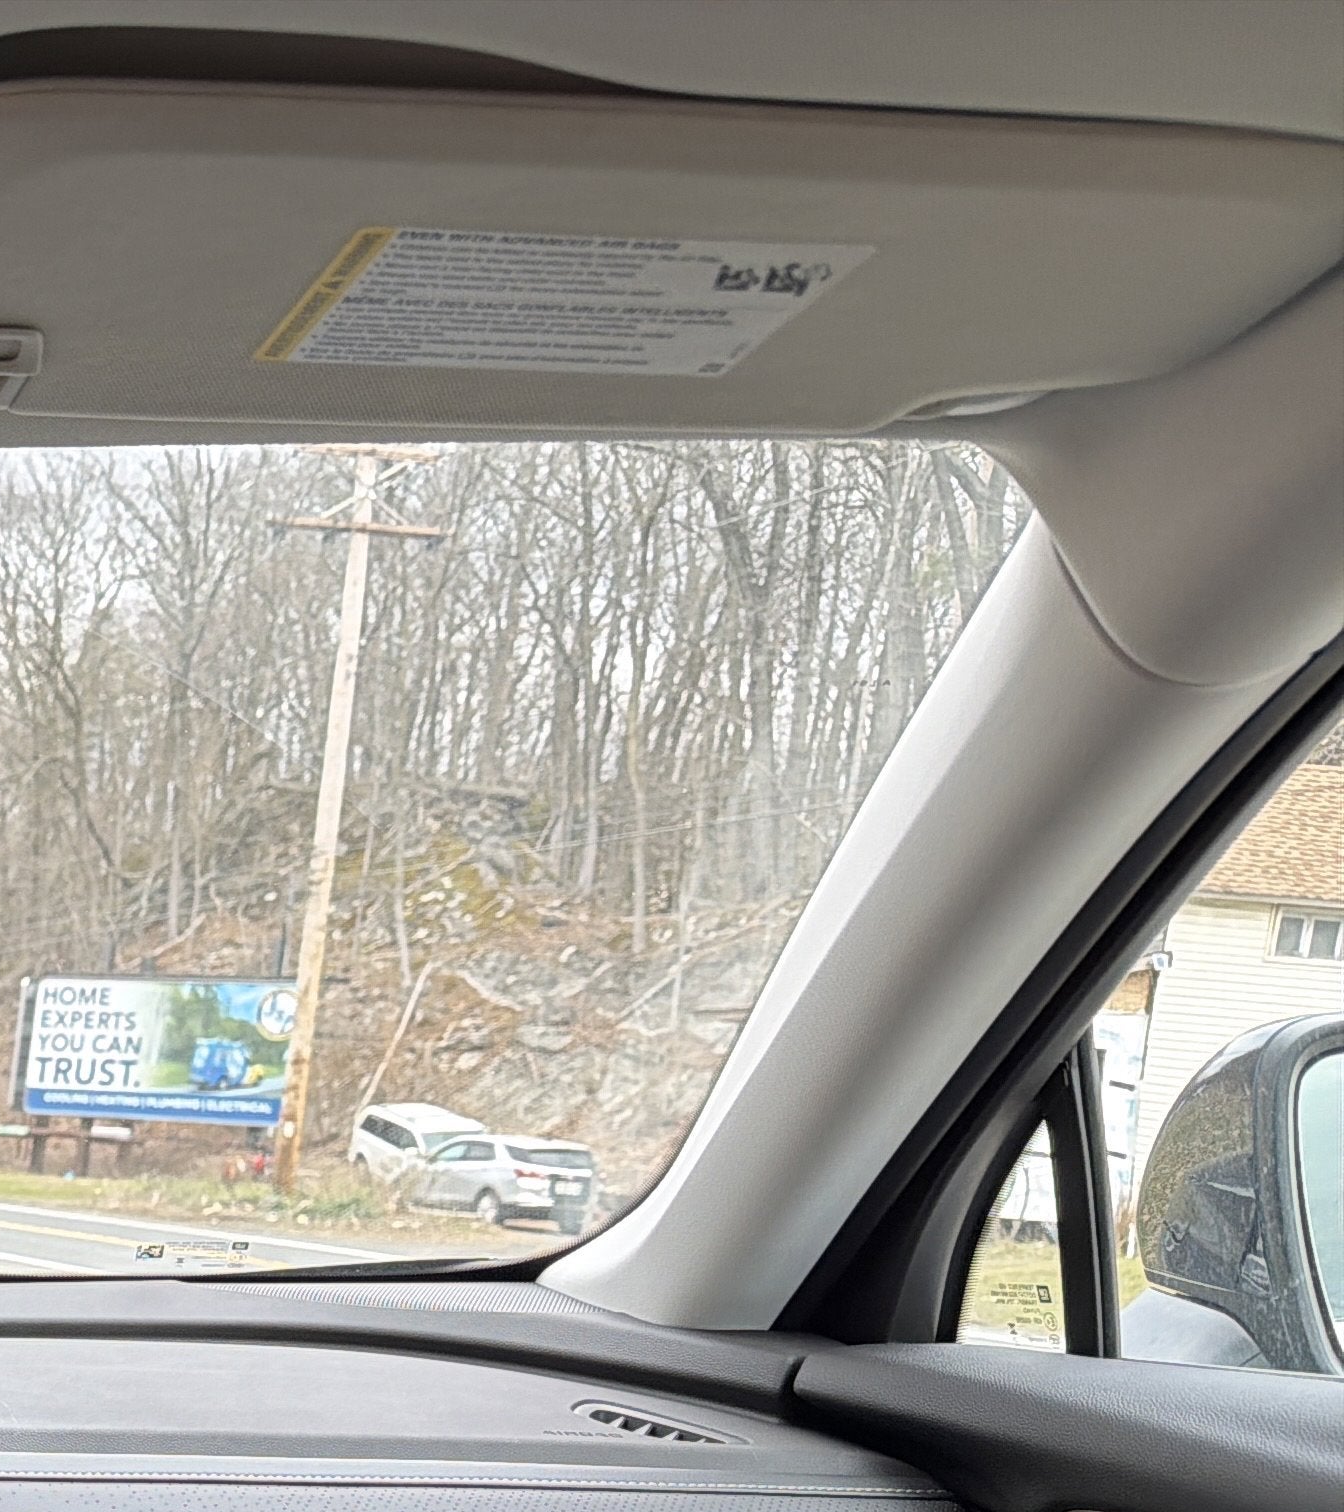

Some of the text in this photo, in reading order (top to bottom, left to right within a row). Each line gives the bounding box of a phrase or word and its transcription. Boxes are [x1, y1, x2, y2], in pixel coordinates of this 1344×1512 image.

[42, 986, 111, 1006] HOME
[40, 1009, 137, 1030] EXPERTS
[38, 1033, 143, 1054] YOU CAN
[35, 1056, 141, 1088] TRUST.
